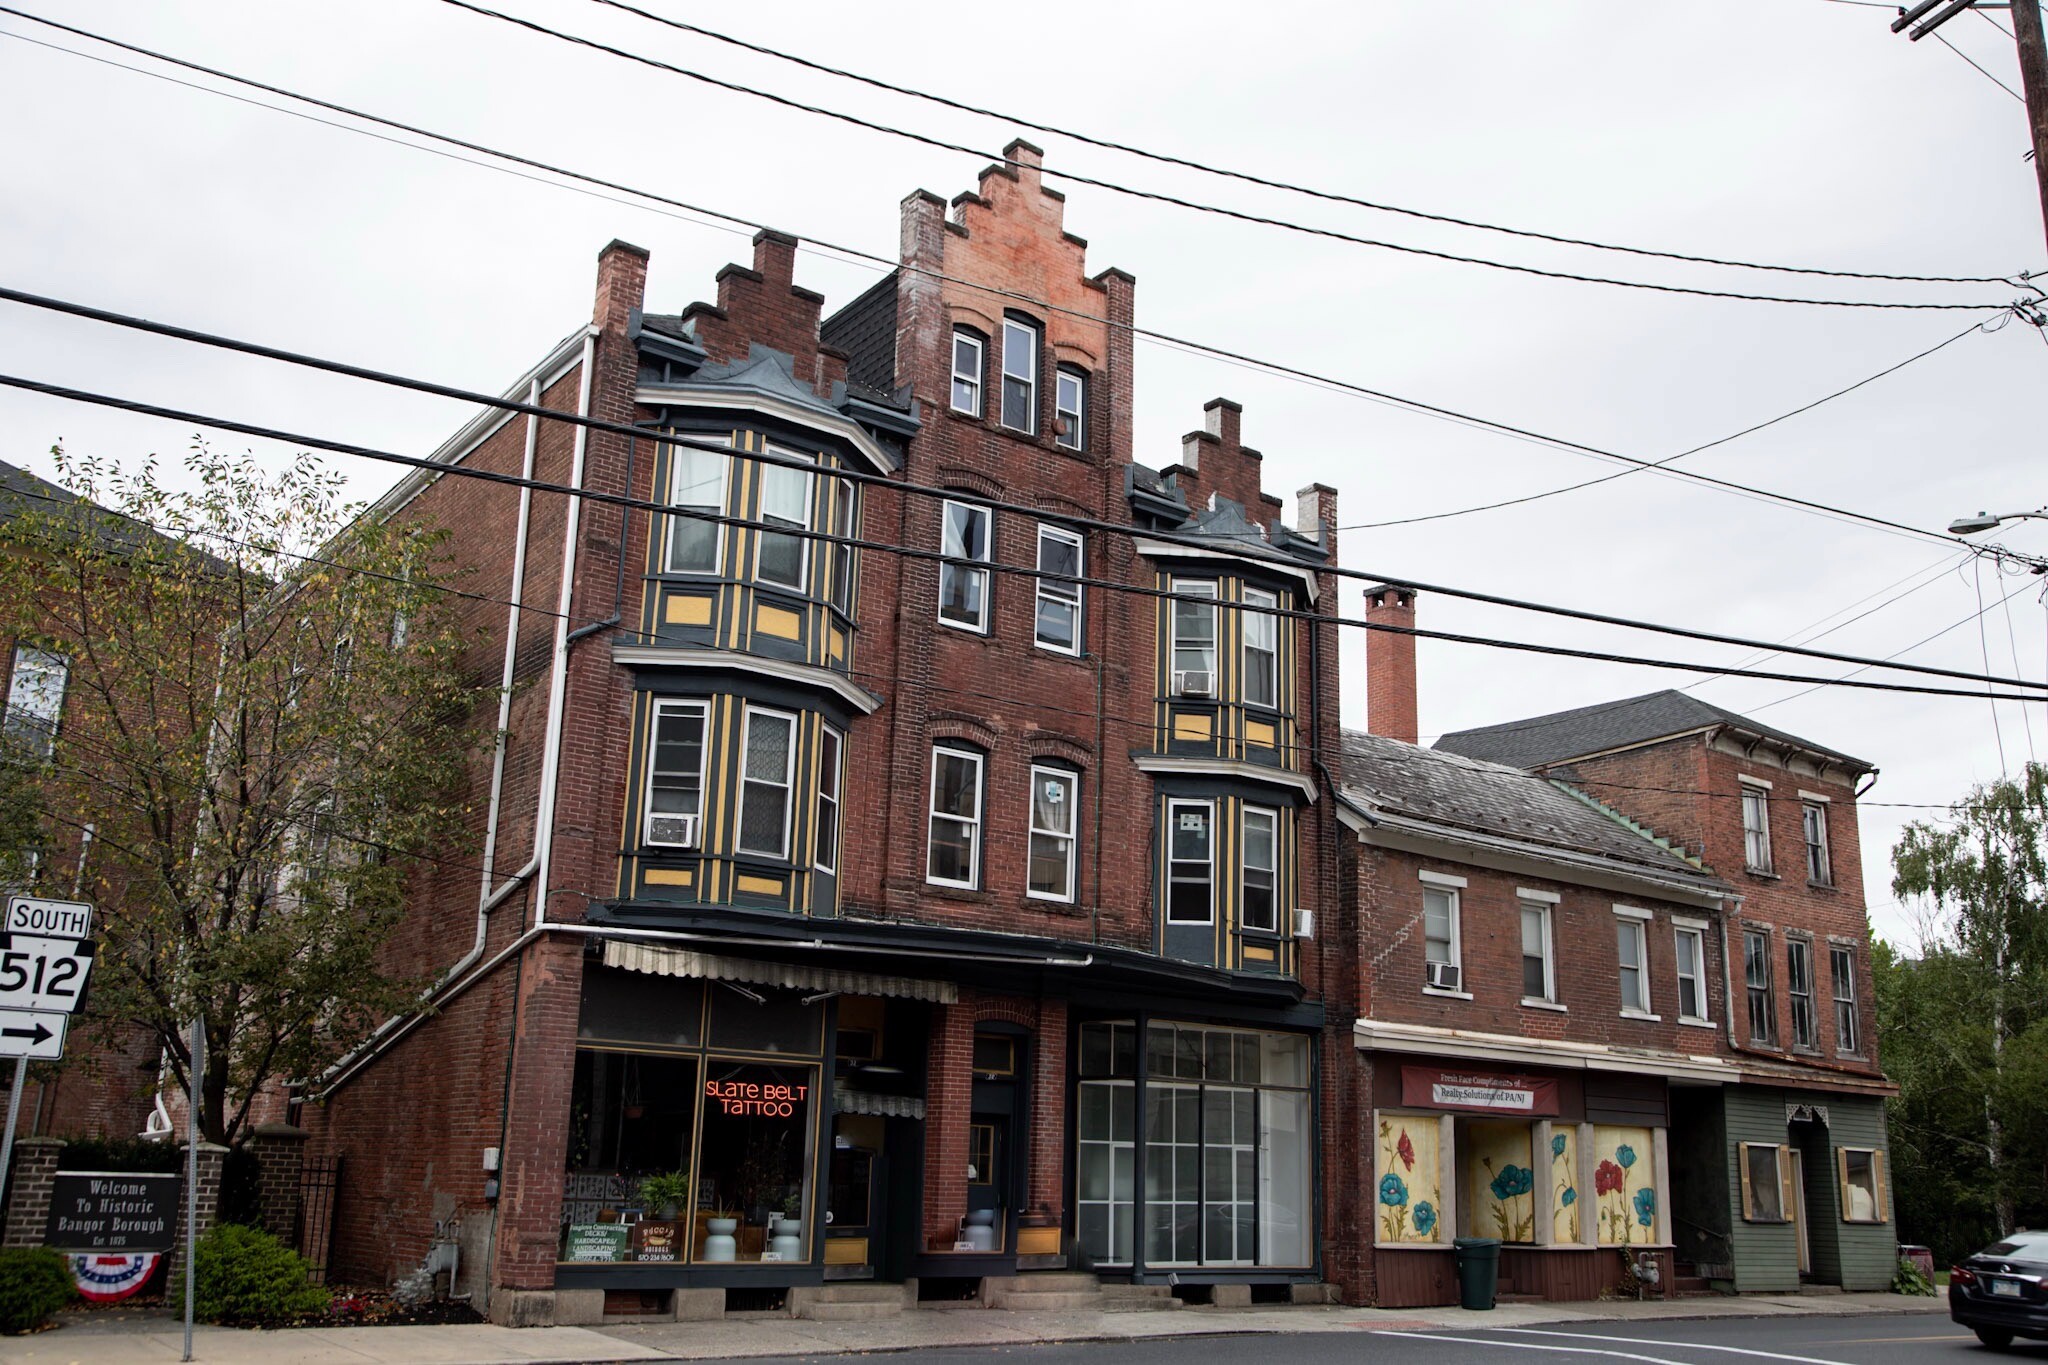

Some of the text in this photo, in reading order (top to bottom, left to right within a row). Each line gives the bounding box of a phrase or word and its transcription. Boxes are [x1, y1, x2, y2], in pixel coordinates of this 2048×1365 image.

[14, 904, 86, 933] SOUTH
[0, 952, 79, 997] 512
[1440, 1073, 1458, 1083] Fresh
[1458, 1075, 1473, 1084] Face
[1473, 1076, 1513, 1088] Compliments
[1514, 1079, 1521, 1088] of
[1441, 1087, 1525, 1104] Realty Solutions of PA/NJ
[90, 1180, 147, 1195] Welcome
[77, 1198, 154, 1214] To Historic
[58, 1217, 164, 1234] Bangor Borough
